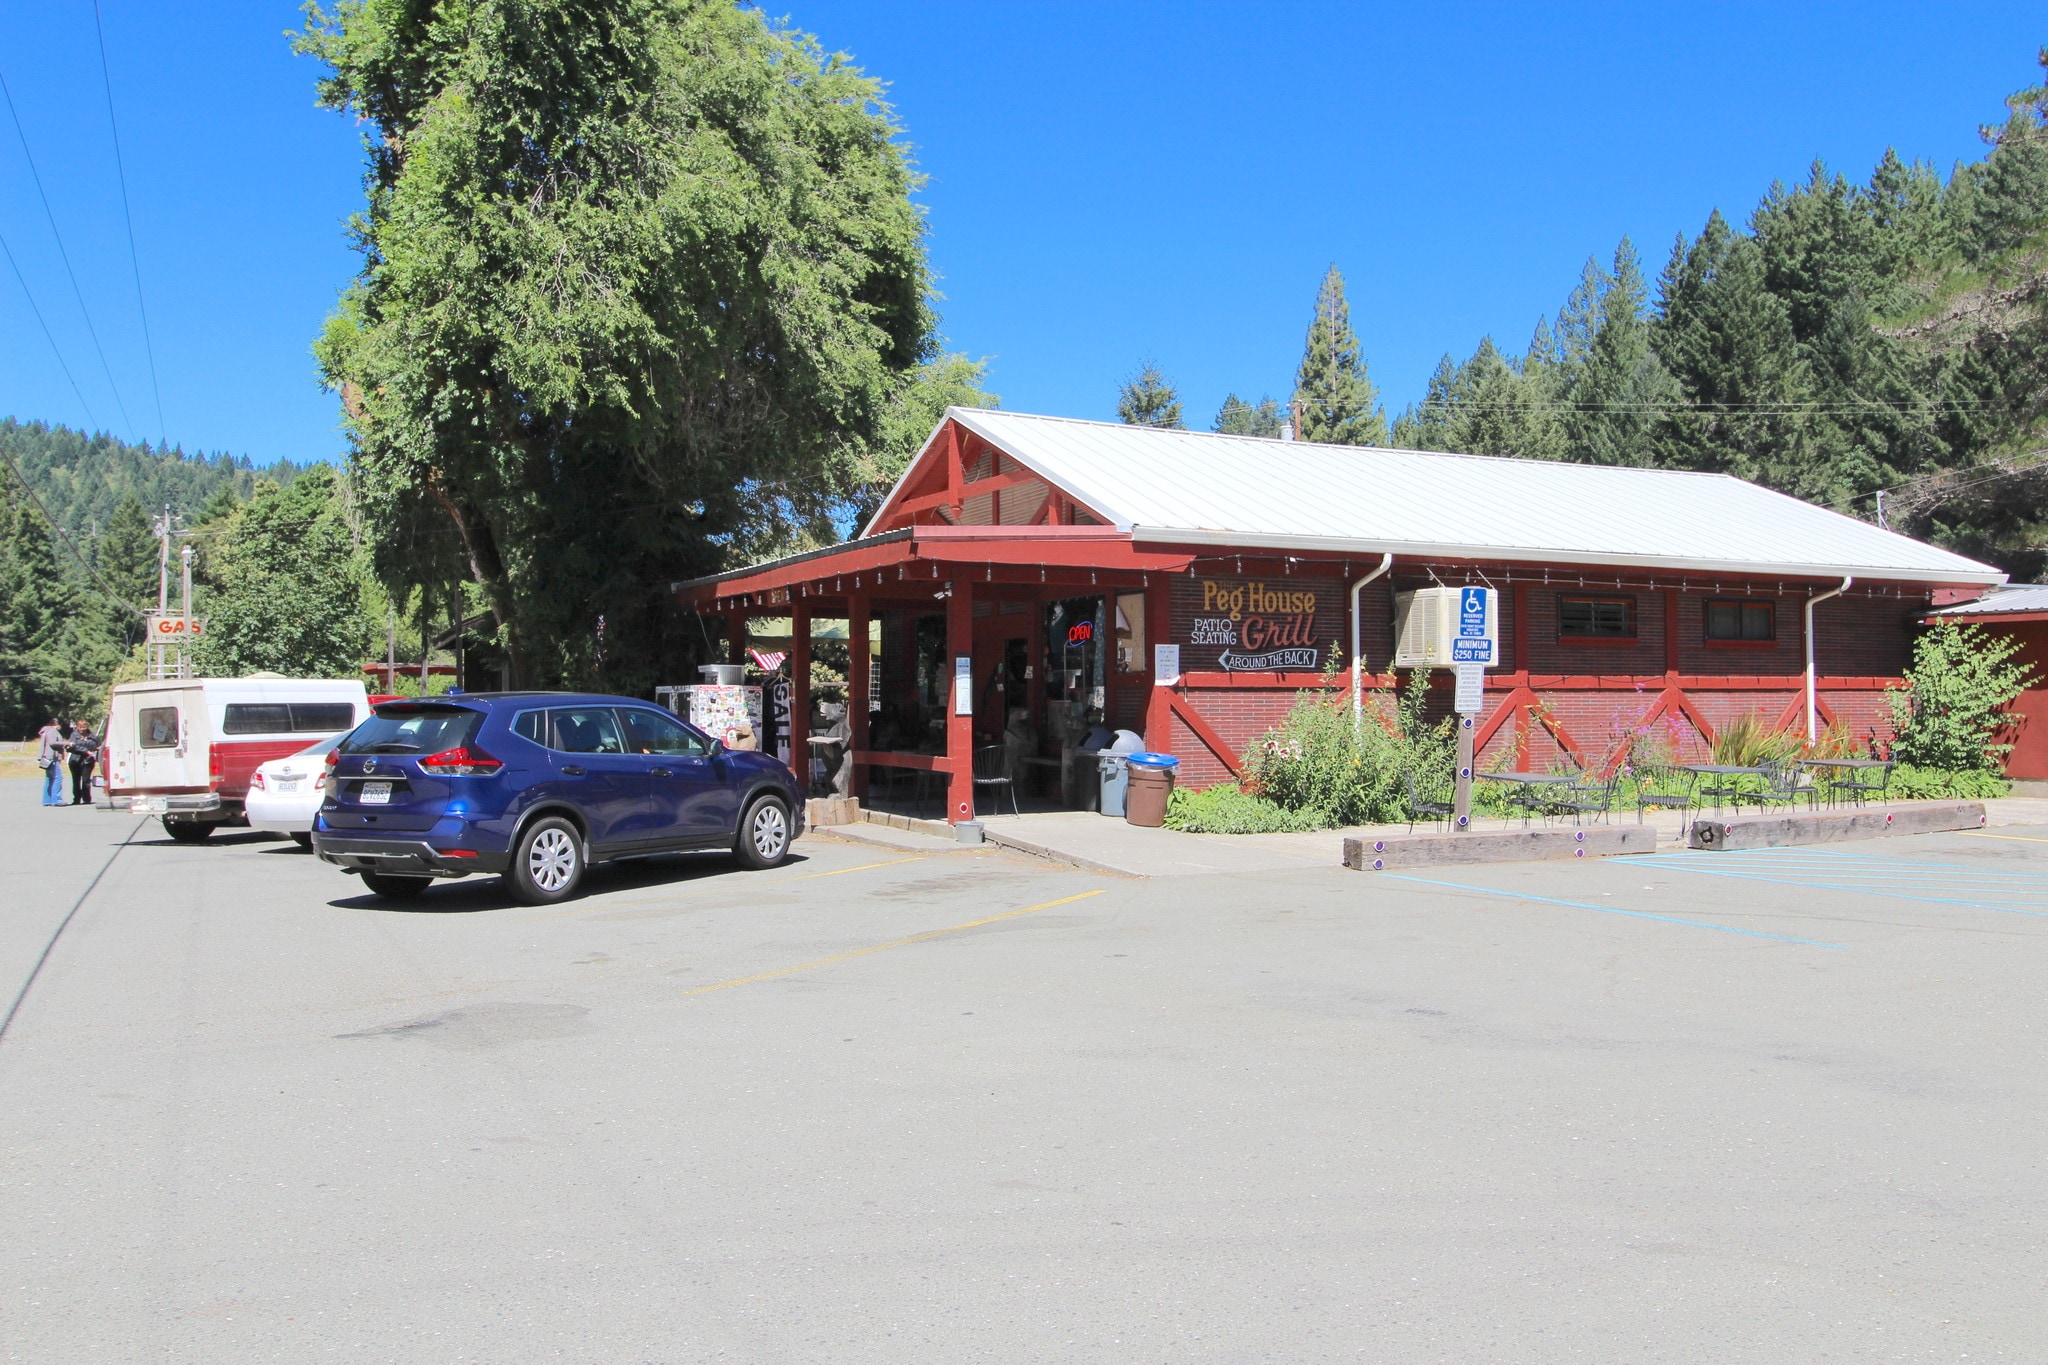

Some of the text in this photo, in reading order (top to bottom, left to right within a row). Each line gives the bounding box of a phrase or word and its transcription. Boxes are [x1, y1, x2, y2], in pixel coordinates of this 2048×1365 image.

[1203, 580, 1316, 621] Peg House
[158, 620, 202, 635] GAS
[1069, 624, 1092, 642] OPEN
[1194, 618, 1232, 632] PATIO
[1241, 614, 1318, 650] Grill
[1191, 631, 1237, 645] SEATING
[1457, 640, 1489, 650] MINIMUM
[1228, 650, 1311, 668] AROUND THE BACK
[1454, 649, 1491, 660] $250 FINE
[774, 684, 791, 749] SALE
